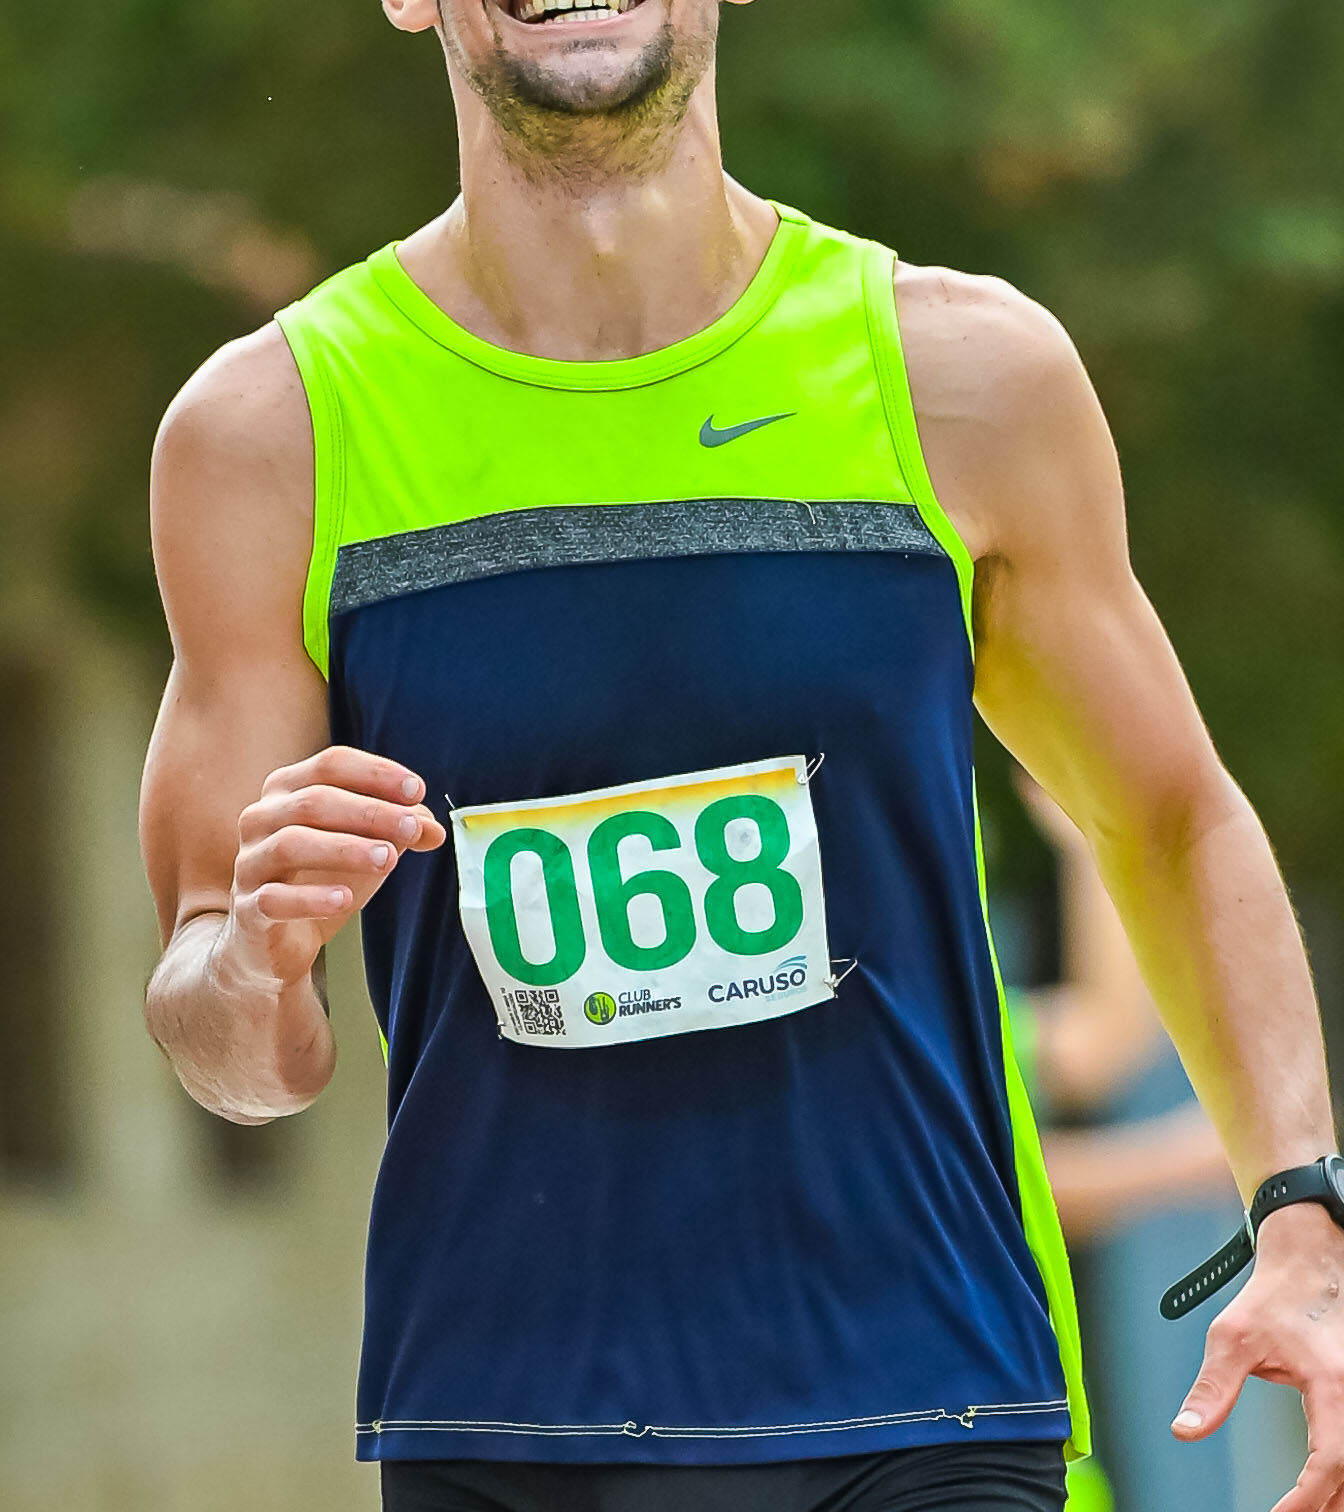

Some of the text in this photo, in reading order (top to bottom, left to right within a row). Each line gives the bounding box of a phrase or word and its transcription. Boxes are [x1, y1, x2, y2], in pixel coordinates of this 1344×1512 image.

[484, 794, 803, 986] 068
[618, 989, 652, 1004] CLUB
[708, 968, 806, 1003] CARUSO
